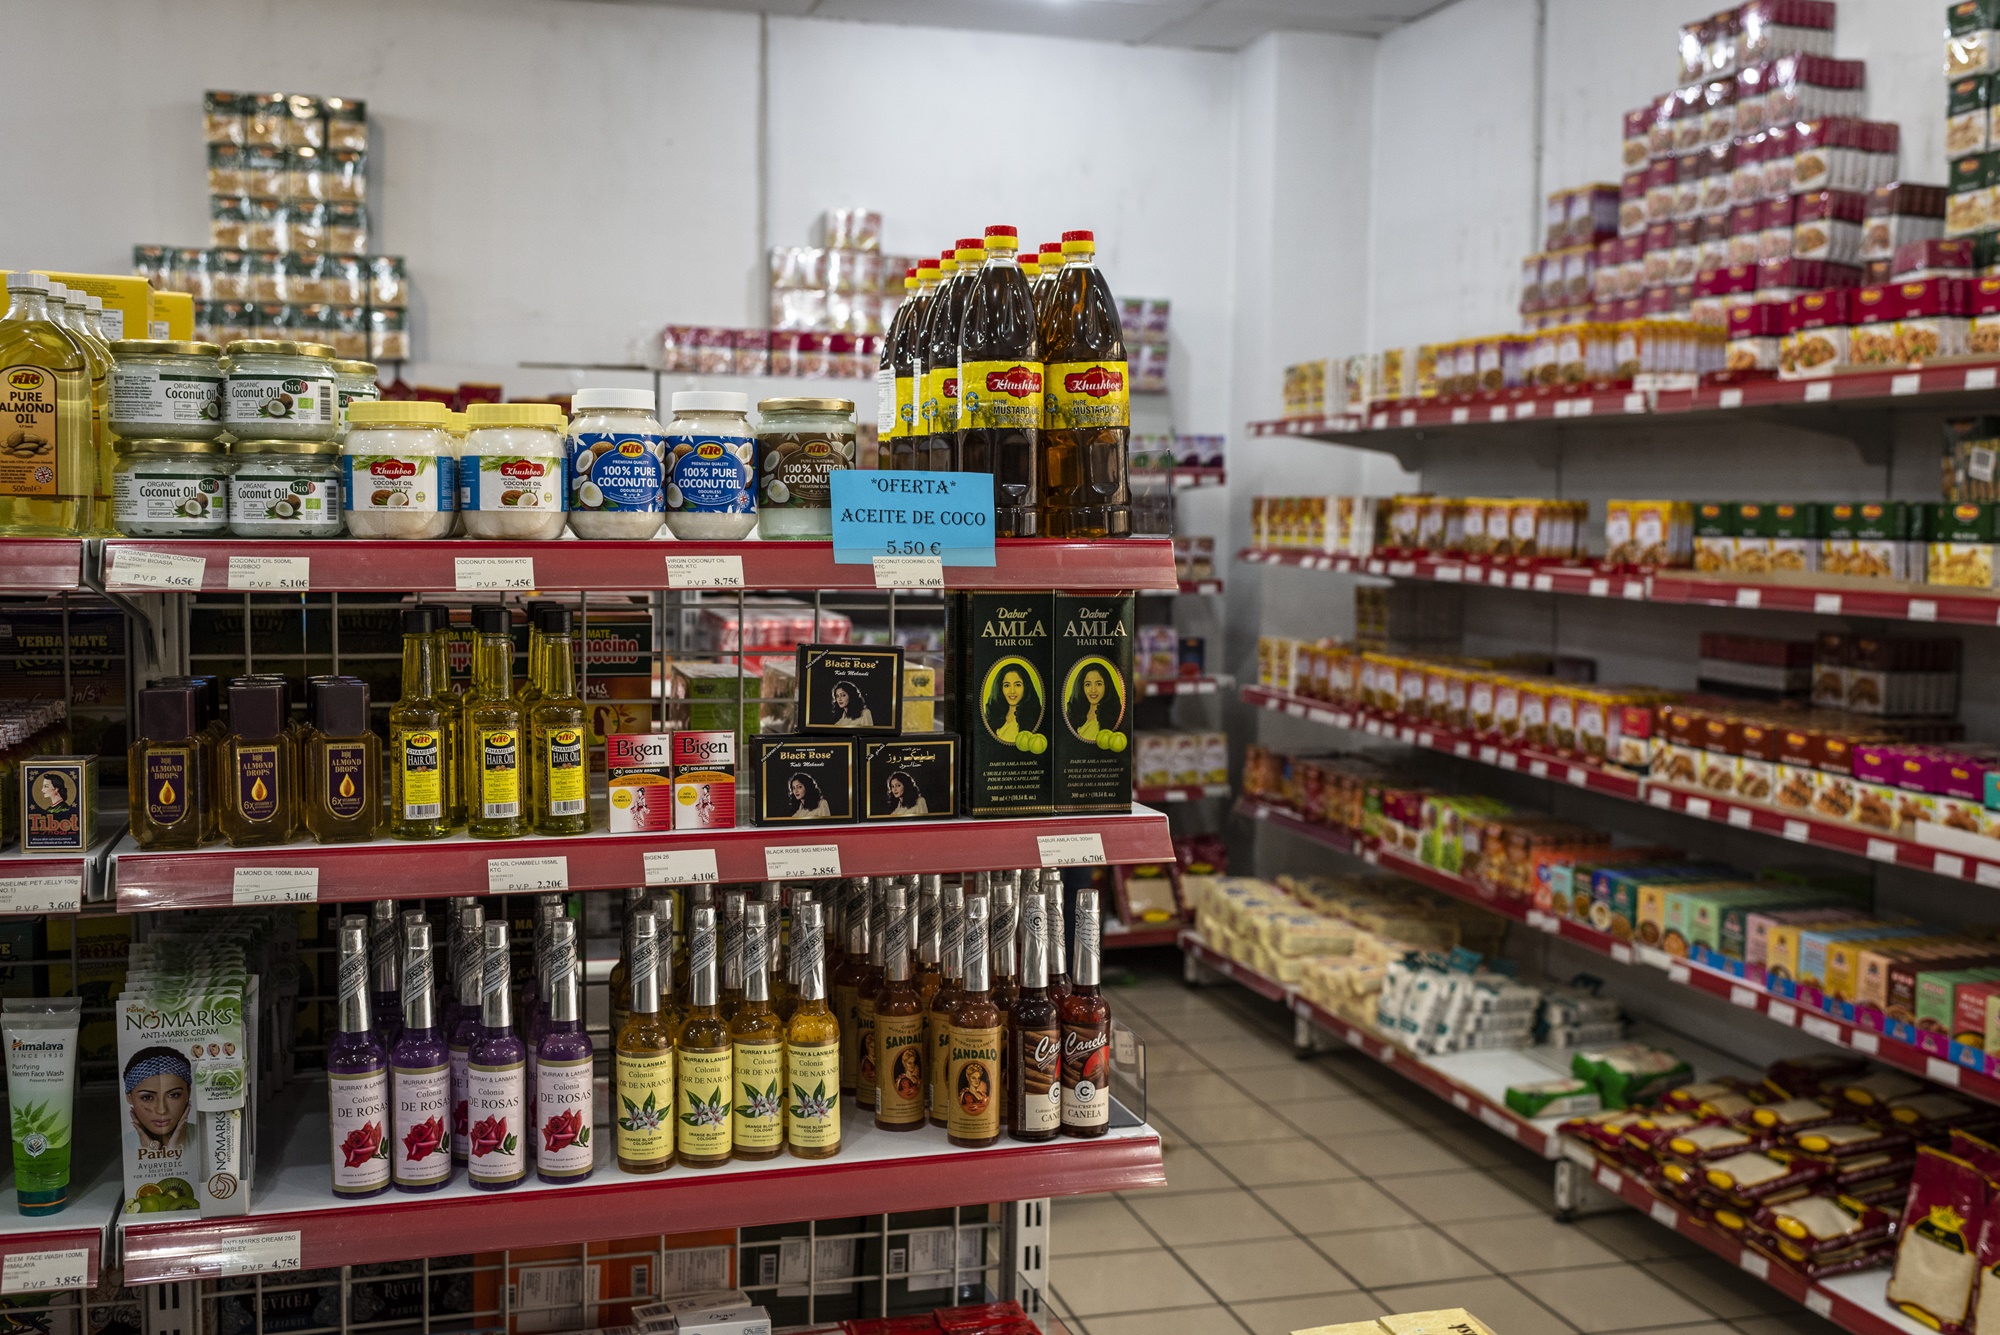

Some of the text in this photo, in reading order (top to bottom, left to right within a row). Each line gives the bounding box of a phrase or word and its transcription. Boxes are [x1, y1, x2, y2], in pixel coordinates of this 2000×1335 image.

[11, 372, 41, 386] KTC
[990, 378, 1040, 391] Khushboo
[284, 381, 301, 392] bio
[1069, 379, 1121, 391] Khushboo
[10, 391, 43, 402] PURE
[165, 388, 216, 401] Coconut Oil
[231, 387, 280, 399] Coconut Oil
[0, 403, 54, 413] ALMOND
[993, 406, 1030, 415] MUSTARD
[1072, 407, 1110, 415] MUSTARD
[15, 414, 38, 424] OIL
[620, 443, 643, 454] KTC
[699, 445, 720, 456] KTC
[374, 466, 412, 476] Khushboo
[504, 466, 543, 476] Khushboo
[602, 466, 656, 477] 100% PURE
[683, 467, 738, 478] 100% PURE
[783, 464, 811, 473] 100%
[200, 482, 214, 492] bio
[597, 476, 644, 487] COCONUT
[678, 478, 728, 488] COCONUT
[139, 486, 197, 497] Coconut Oil
[238, 487, 288, 499] Coconut Oil
[292, 483, 308, 493] bio
[840, 508, 986, 526] ACEITE DE COCO
[886, 540, 941, 556] 5.50 €
[118, 549, 204, 563] ORGANIC VIRGIN COCONUT
[147, 558, 173, 566] BIOASIA
[165, 575, 194, 587] 4,65€
[918, 578, 943, 587] 8,60€
[995, 607, 1029, 619] Dabur
[1078, 607, 1111, 619] Dabur
[980, 619, 1047, 638] AMLA
[1062, 619, 1128, 637] AMLA
[16, 635, 64, 647] YERBA
[1076, 638, 1115, 646] HAIR OIL
[824, 659, 876, 669] Black Rose
[407, 747, 437, 755] CHAMBELI
[616, 739, 663, 762] Bigen
[682, 737, 728, 760] Bigen
[779, 751, 832, 760] Black Rose
[242, 761, 274, 770] ALMOND
[331, 758, 362, 766] ALMOND
[150, 765, 183, 773] ALMOND
[246, 768, 271, 777] DROPS
[154, 772, 179, 780] DROPS
[29, 813, 79, 831] Tibet
[1082, 854, 1104, 864] 6,70€
[812, 866, 837, 876] 2,85€
[691, 872, 716, 882] 4,10€
[537, 880, 563, 890] 2,20€
[284, 892, 313, 902] 3,10€
[48, 900, 78, 911] 3,60€
[125, 1008, 233, 1031] NOMARKS
[140, 1028, 219, 1040] ANTI-MARKS CREAM
[12, 1039, 64, 1051] Himalaya
[1064, 1031, 1108, 1056] Canela
[952, 1048, 997, 1061] SANDALO
[752, 1058, 777, 1066] Colonia
[46, 1069, 65, 1077] Wash
[628, 1070, 654, 1078] Colonia
[478, 1087, 505, 1096] Colonia
[553, 1082, 580, 1091] Colonia
[352, 1094, 379, 1105] Colonia
[416, 1089, 442, 1099] Colonia
[540, 1089, 592, 1104] DE ROSAS
[401, 1101, 417, 1112] DE
[481, 1096, 519, 1109] ROSAS
[337, 1108, 353, 1118] DE
[1067, 1109, 1102, 1119] CANELA
[137, 1146, 183, 1161] Parley
[137, 1161, 183, 1170] AYURVEDIC
[271, 1258, 299, 1270] 4,75€
[54, 1275, 84, 1287] 3,85€
